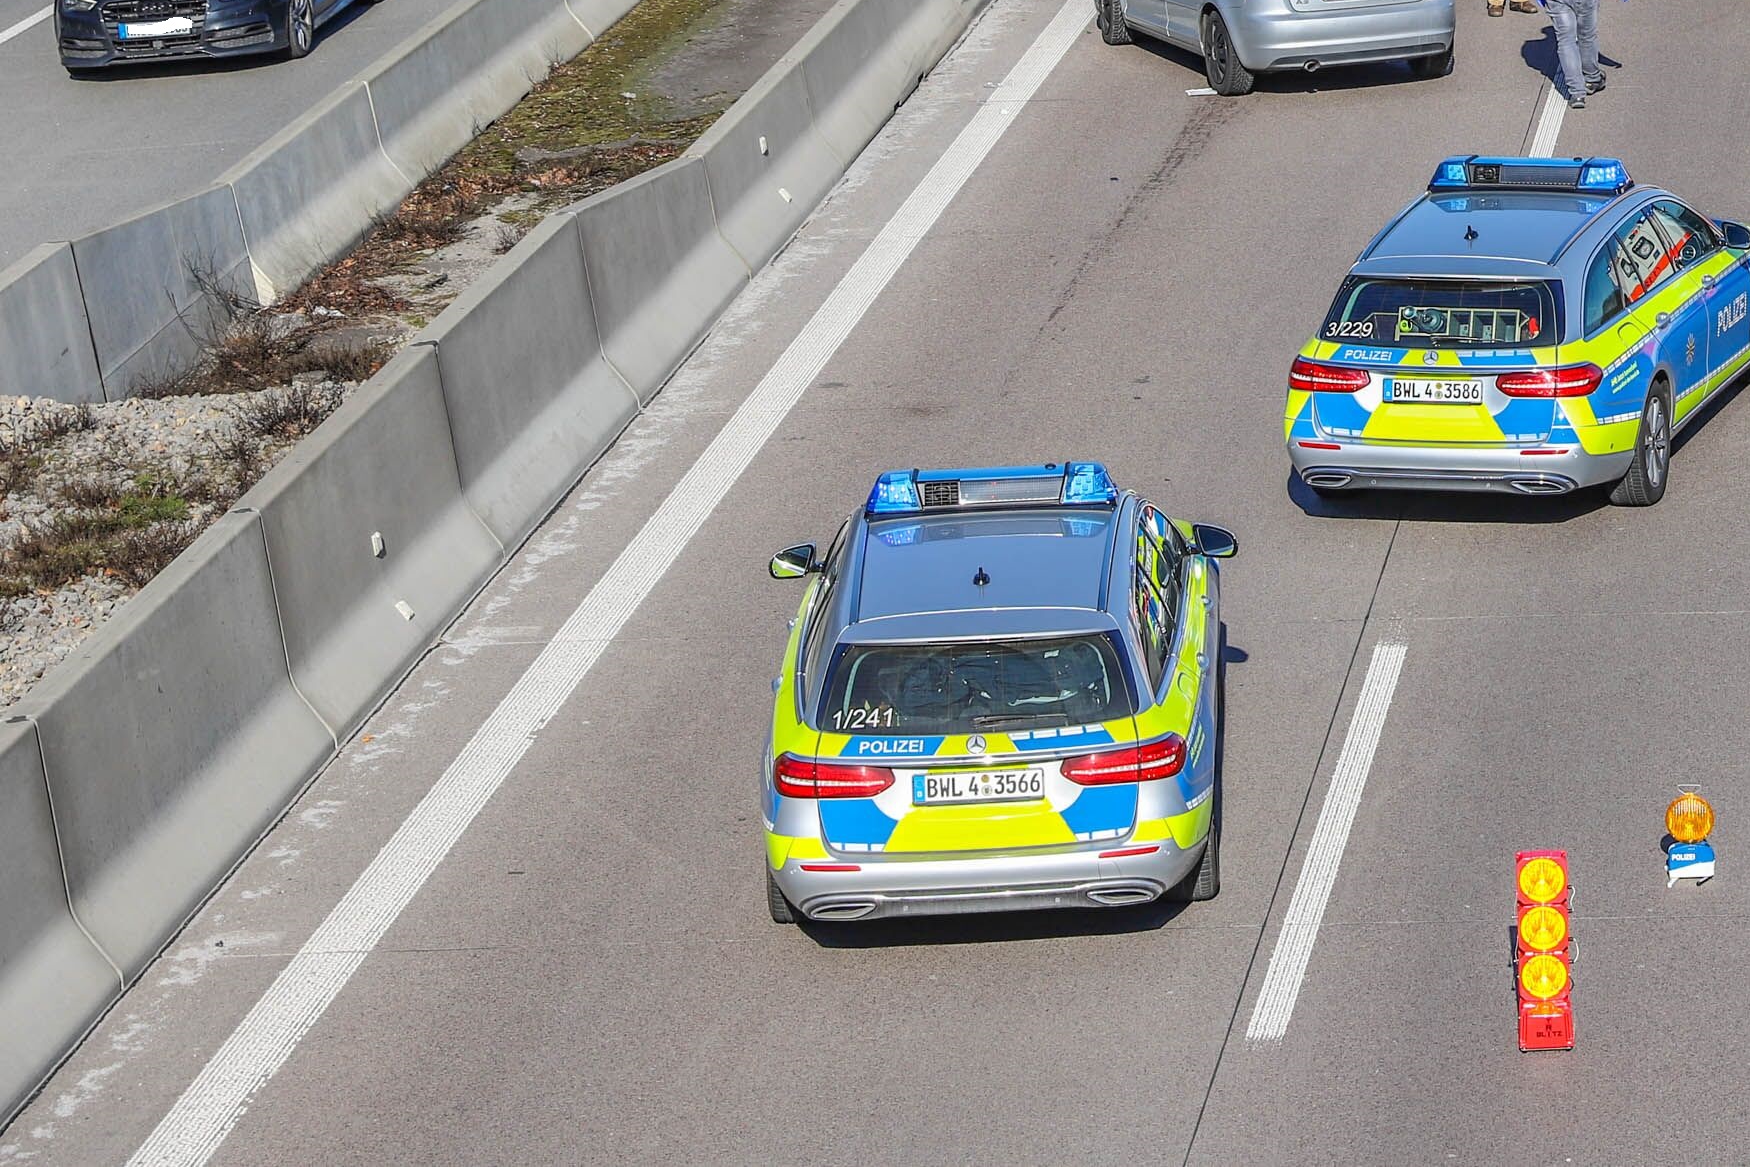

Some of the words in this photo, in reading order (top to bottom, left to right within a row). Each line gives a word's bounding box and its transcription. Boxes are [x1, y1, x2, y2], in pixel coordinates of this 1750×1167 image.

[1717, 291, 1747, 338] POLIZEI
[1325, 321, 1374, 338] 3/229
[1344, 349, 1393, 362] POLIZEI
[1393, 381, 1421, 400] BWL
[1424, 381, 1433, 399] 4
[1443, 380, 1480, 400] 3586
[832, 708, 894, 730] 1/241
[859, 739, 925, 755] POLIZEI
[927, 775, 962, 798] BWL
[968, 774, 979, 796] 4
[994, 771, 1041, 796] 3566
